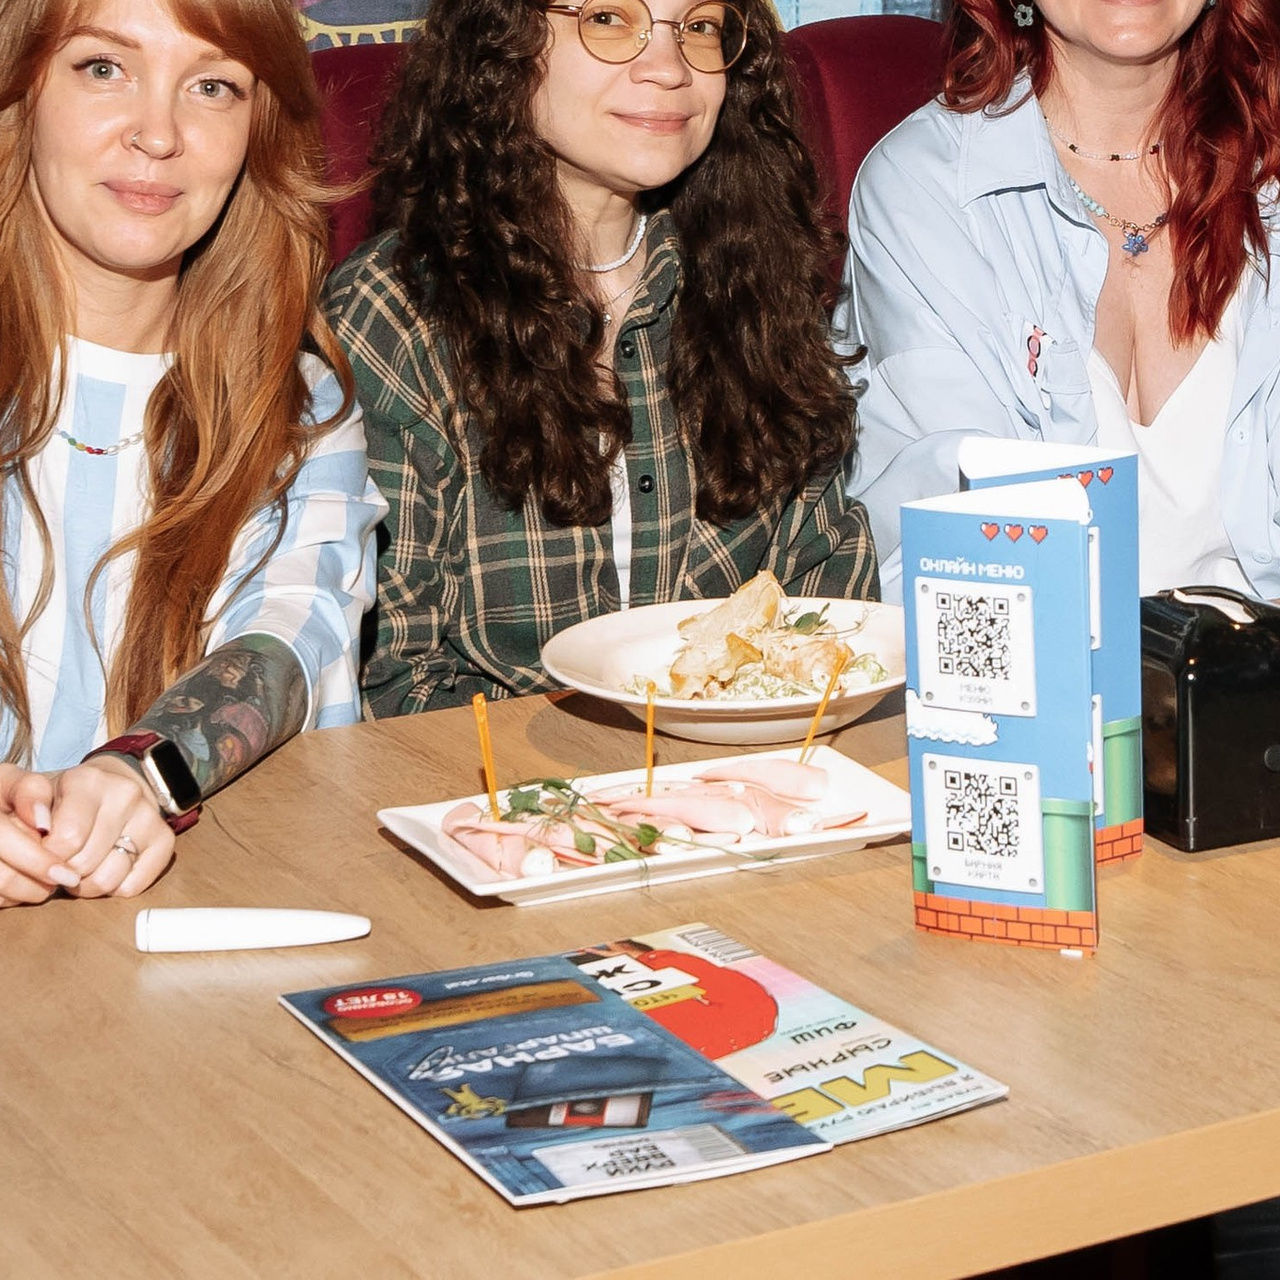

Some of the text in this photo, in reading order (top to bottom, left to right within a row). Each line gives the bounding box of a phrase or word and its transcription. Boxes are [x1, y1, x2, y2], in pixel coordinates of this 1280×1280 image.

[919, 556, 1025, 580] ОНЛАЙН МЕНЮ
[763, 1037, 893, 1085] СЫРНЫЕ
